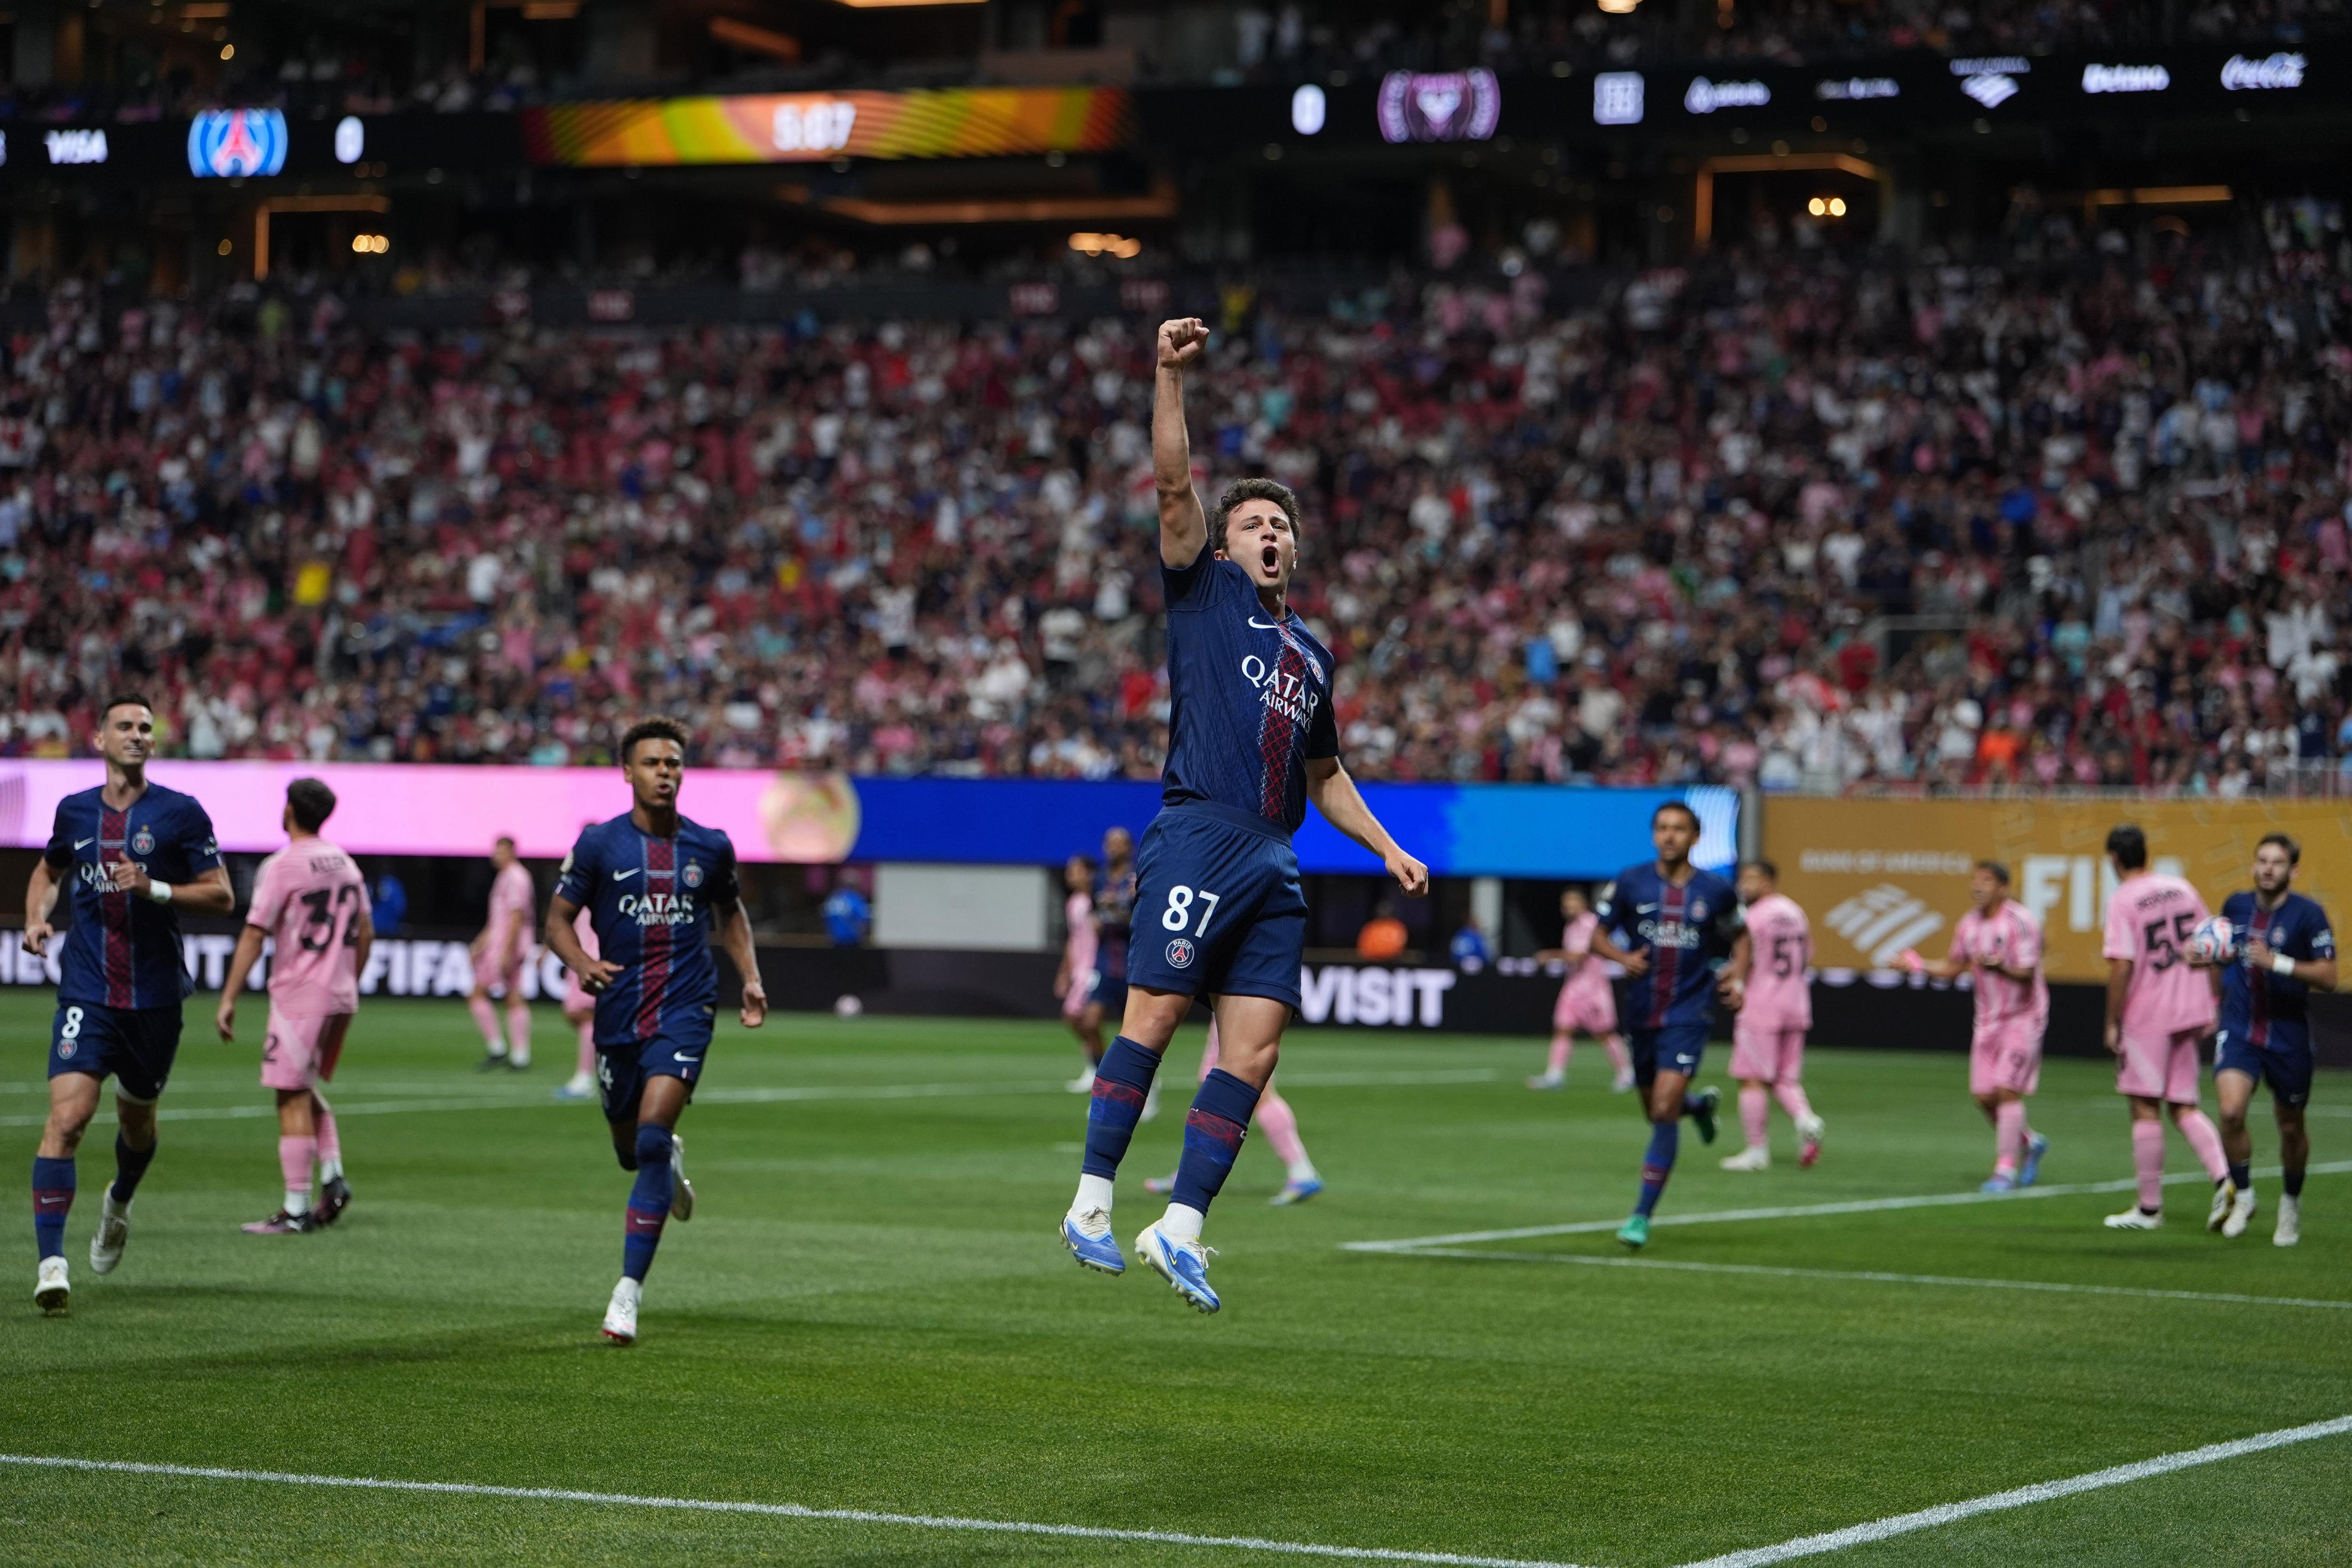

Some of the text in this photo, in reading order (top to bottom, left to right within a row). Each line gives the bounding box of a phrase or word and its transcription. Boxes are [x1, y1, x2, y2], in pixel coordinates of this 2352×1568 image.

[1242, 655, 1318, 719] QATAR
[1259, 690, 1312, 734] AIRWAYS
[301, 884, 361, 953] 32
[618, 893, 694, 917] QATAR
[1162, 885, 1220, 938] 87
[1173, 941, 1191, 950] PARIS
[1301, 965, 1457, 1028] VISIT
[61, 1006, 84, 1039] 8
